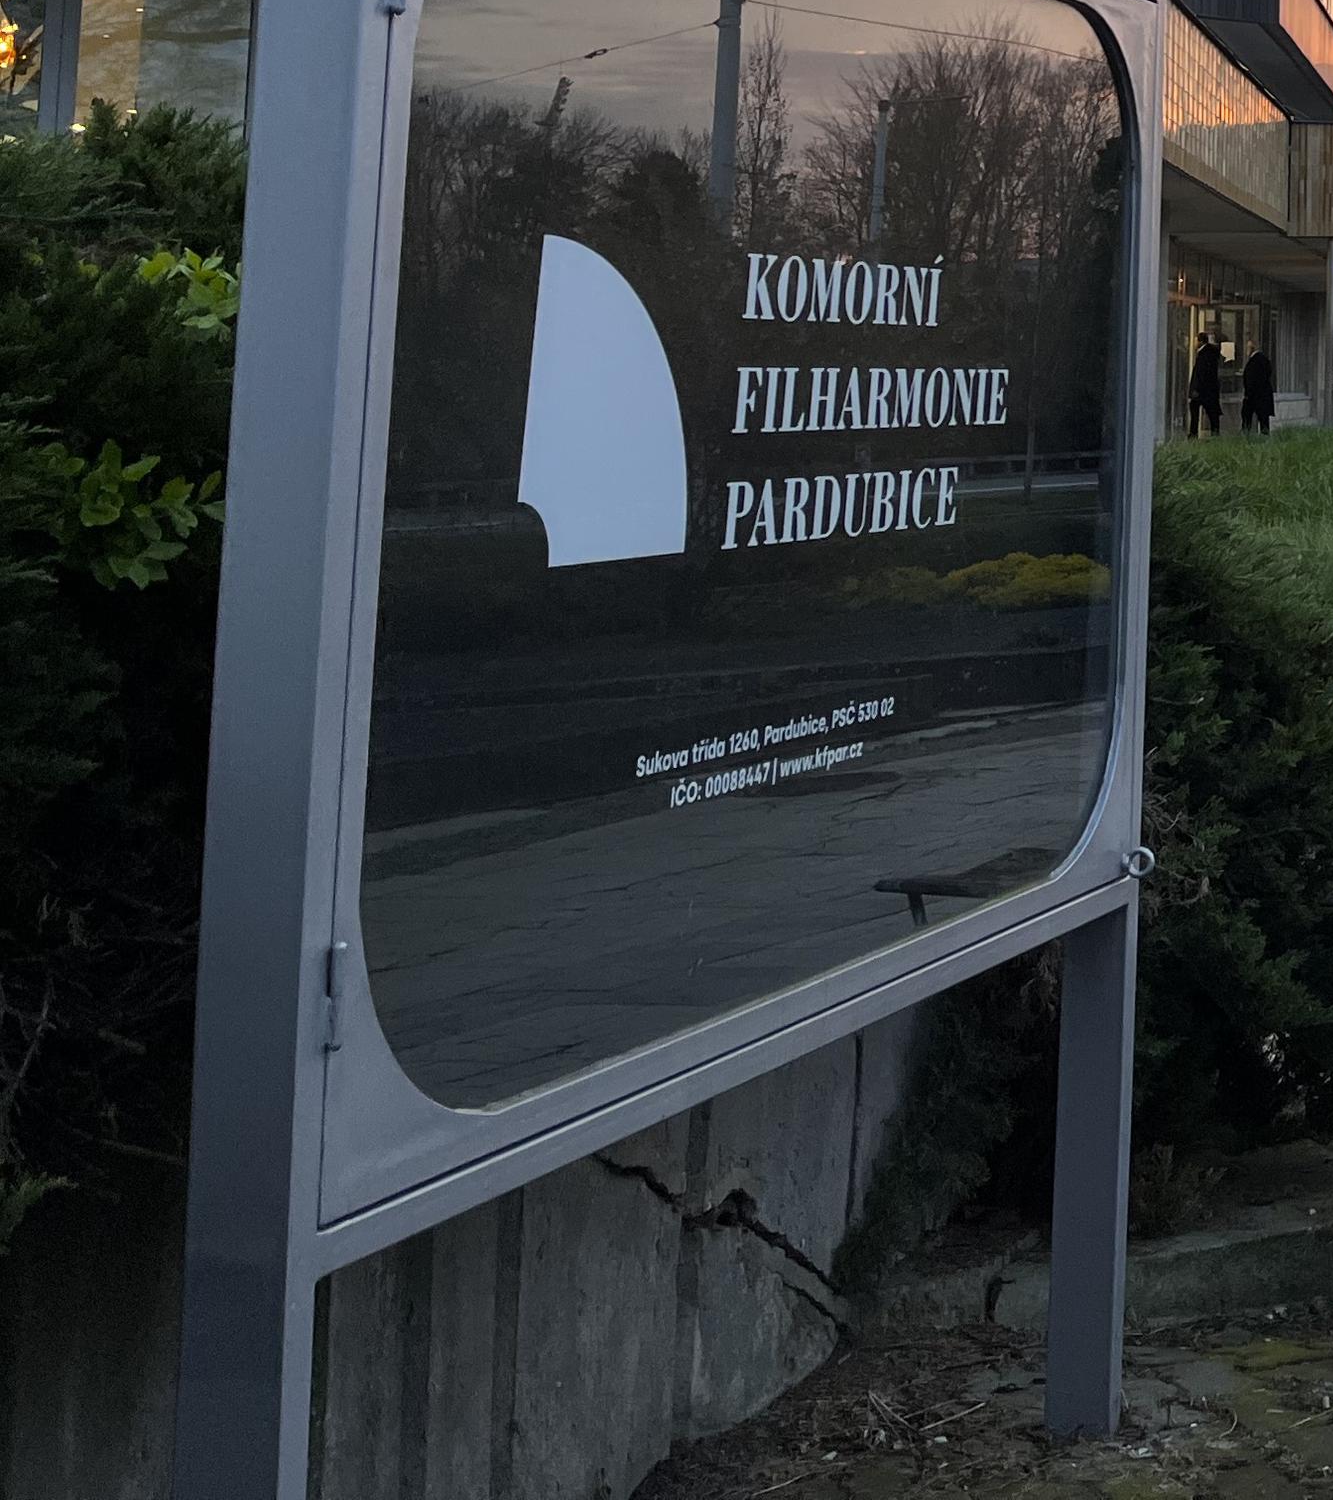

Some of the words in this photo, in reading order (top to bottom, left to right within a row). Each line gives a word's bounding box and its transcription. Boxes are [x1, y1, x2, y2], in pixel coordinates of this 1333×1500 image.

[742, 254, 944, 327] KOMORNÍ
[731, 367, 1009, 434] FILHARMONIE
[721, 466, 959, 550] PARDUBICE
[636, 751, 689, 778] Sukova
[692, 737, 725, 765] třída
[729, 728, 760, 753] 1260,
[763, 715, 829, 746] Pardubice,
[831, 700, 855, 730] PSČ
[857, 698, 878, 722] 530
[880, 696, 895, 716] 02
[670, 779, 702, 808] IČO:
[704, 762, 770, 799] 00088447
[780, 741, 864, 777] www.kfpar.cz
